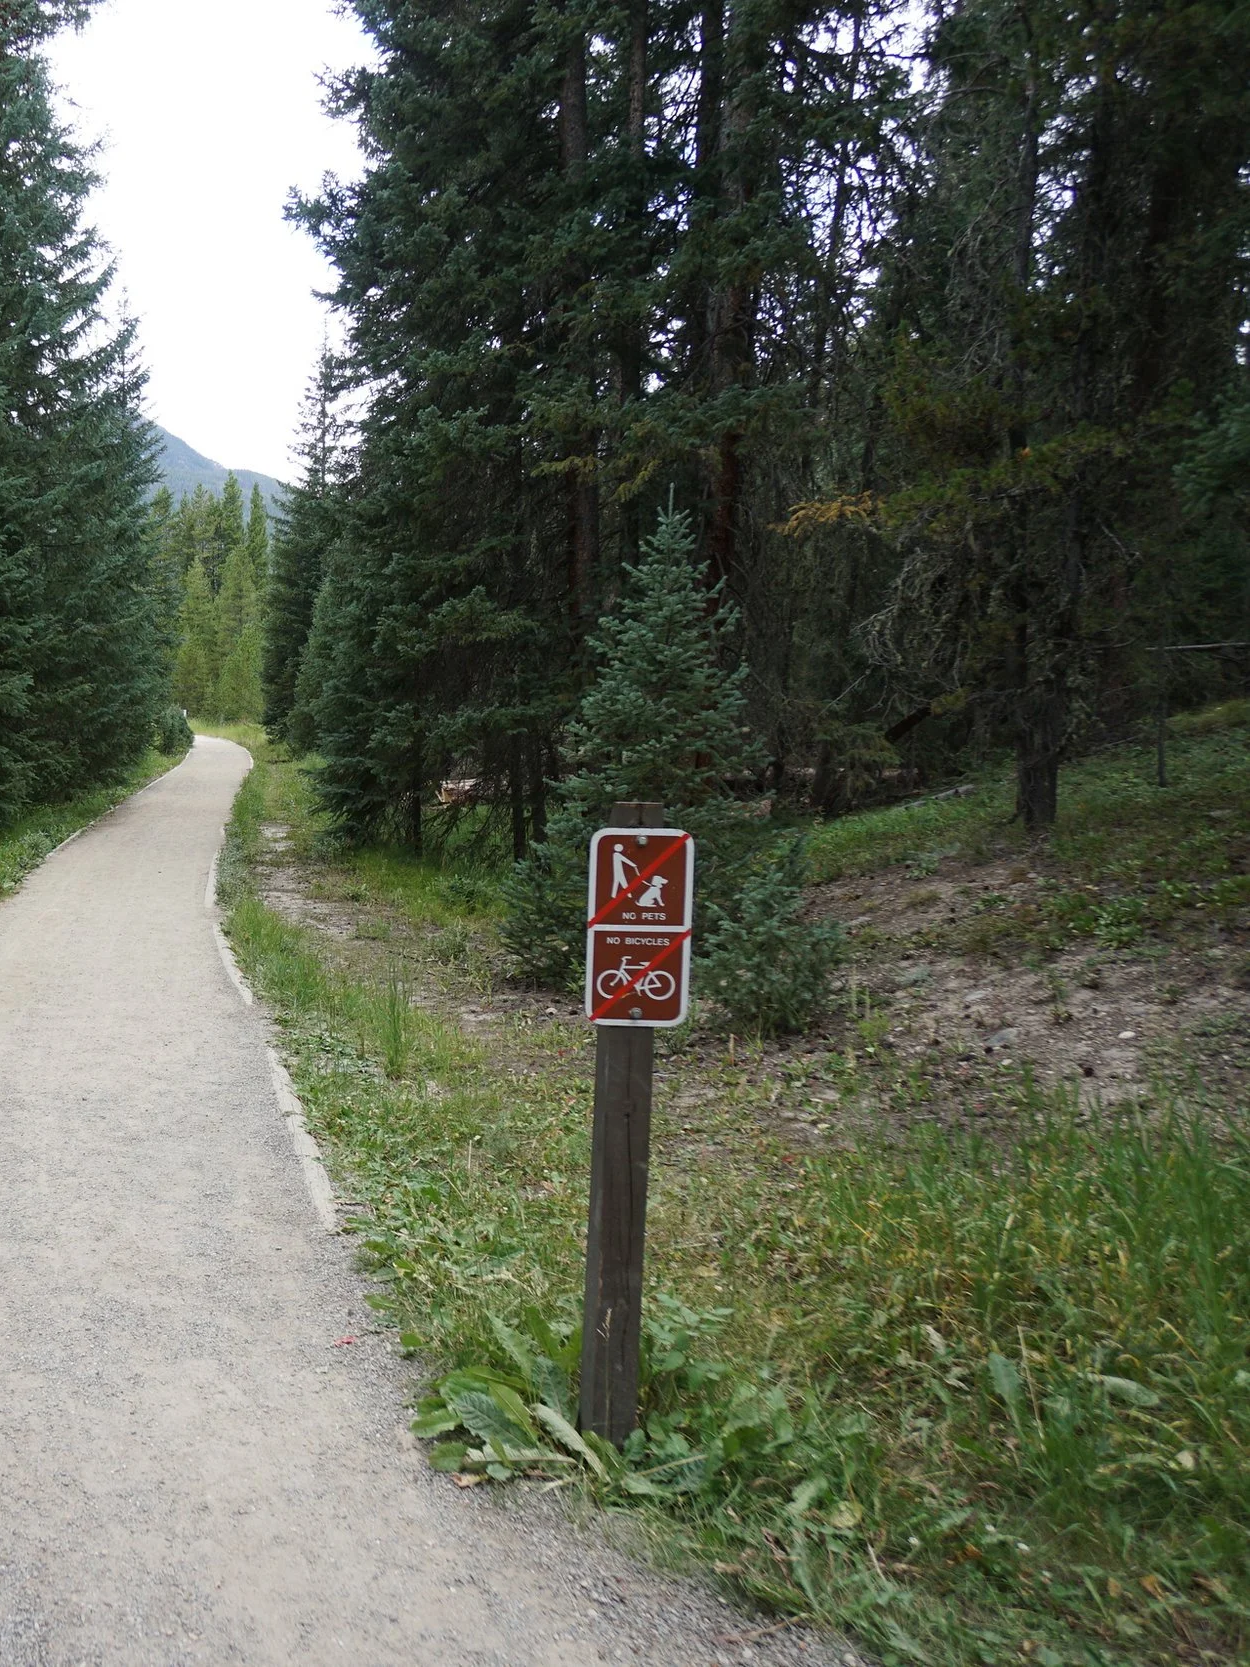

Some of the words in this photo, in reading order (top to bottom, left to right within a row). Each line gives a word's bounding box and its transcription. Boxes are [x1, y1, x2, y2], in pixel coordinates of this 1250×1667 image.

[622, 912, 636, 920] NO
[642, 912, 666, 921] PETS
[606, 937, 620, 945] NO
[625, 937, 670, 946] BICYCLES
